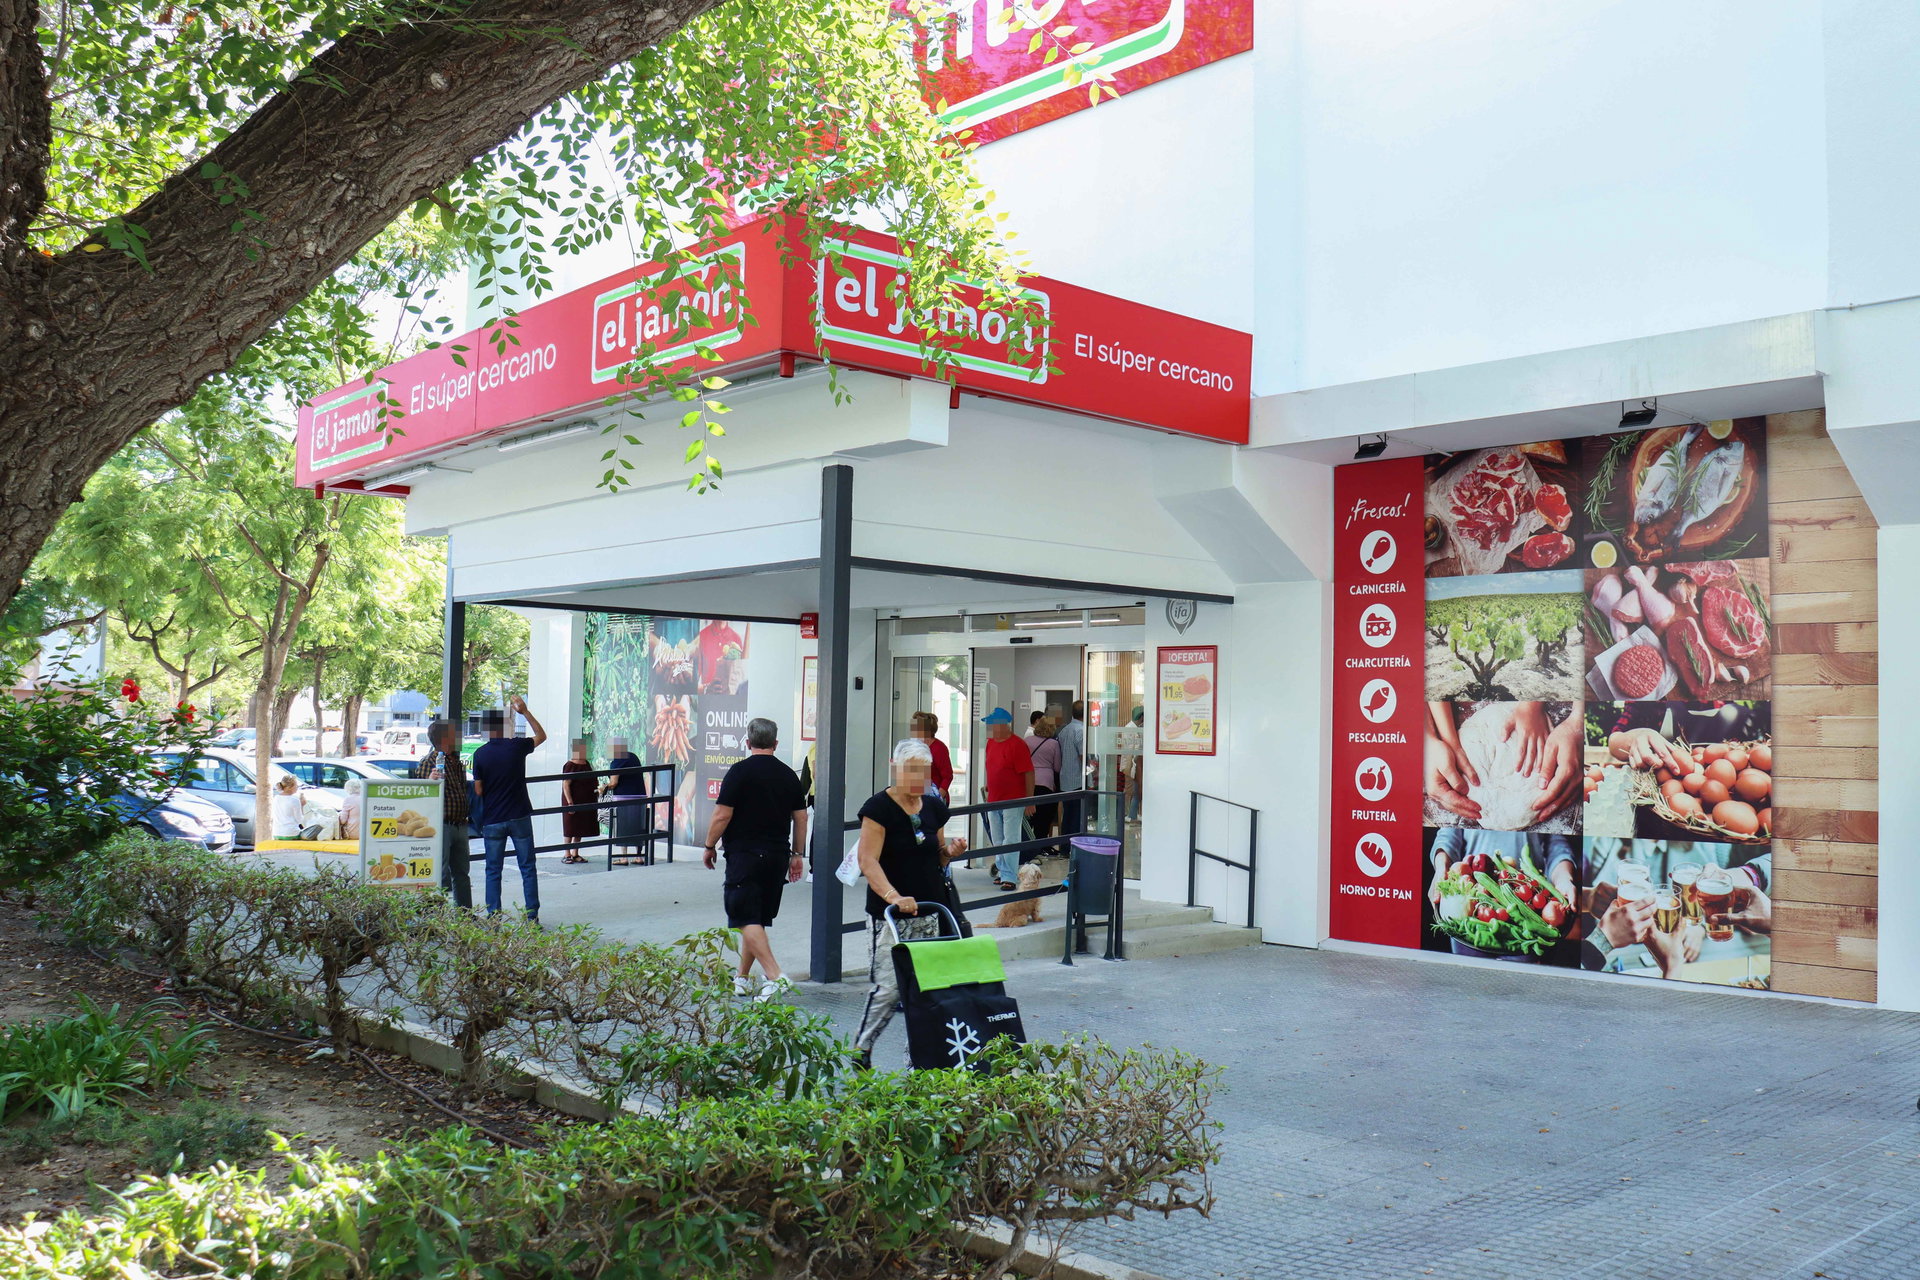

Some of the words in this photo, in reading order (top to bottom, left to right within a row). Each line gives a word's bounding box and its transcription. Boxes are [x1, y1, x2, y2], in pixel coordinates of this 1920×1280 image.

[835, 266, 879, 317] el
[602, 302, 626, 352] el
[1074, 333, 1093, 359] El
[1097, 341, 1155, 373] súper
[1158, 358, 1233, 392] cercano
[410, 381, 425, 416] El
[427, 371, 476, 412] súper
[477, 343, 557, 392] cercano
[316, 414, 329, 450] el
[1345, 492, 1411, 530] ¡Frescos!
[1349, 580, 1406, 595] CARNICERÍA
[1168, 652, 1208, 663] ¡OFERTA!
[1345, 655, 1411, 668] CHARCUTERÍA
[705, 710, 749, 728] ONLINE
[1348, 731, 1407, 744] PESCADERÍA
[377, 785, 430, 796] ¡OFERTA!
[709, 781, 717, 794] el
[1351, 809, 1397, 822] FRUTERÍA
[371, 821, 397, 836] 7,49
[409, 862, 431, 877] 1,49
[1340, 883, 1376, 897] HORNO
[1378, 887, 1390, 898] DE
[1392, 888, 1412, 900] PAN
[986, 1011, 1017, 1023] THERMO
